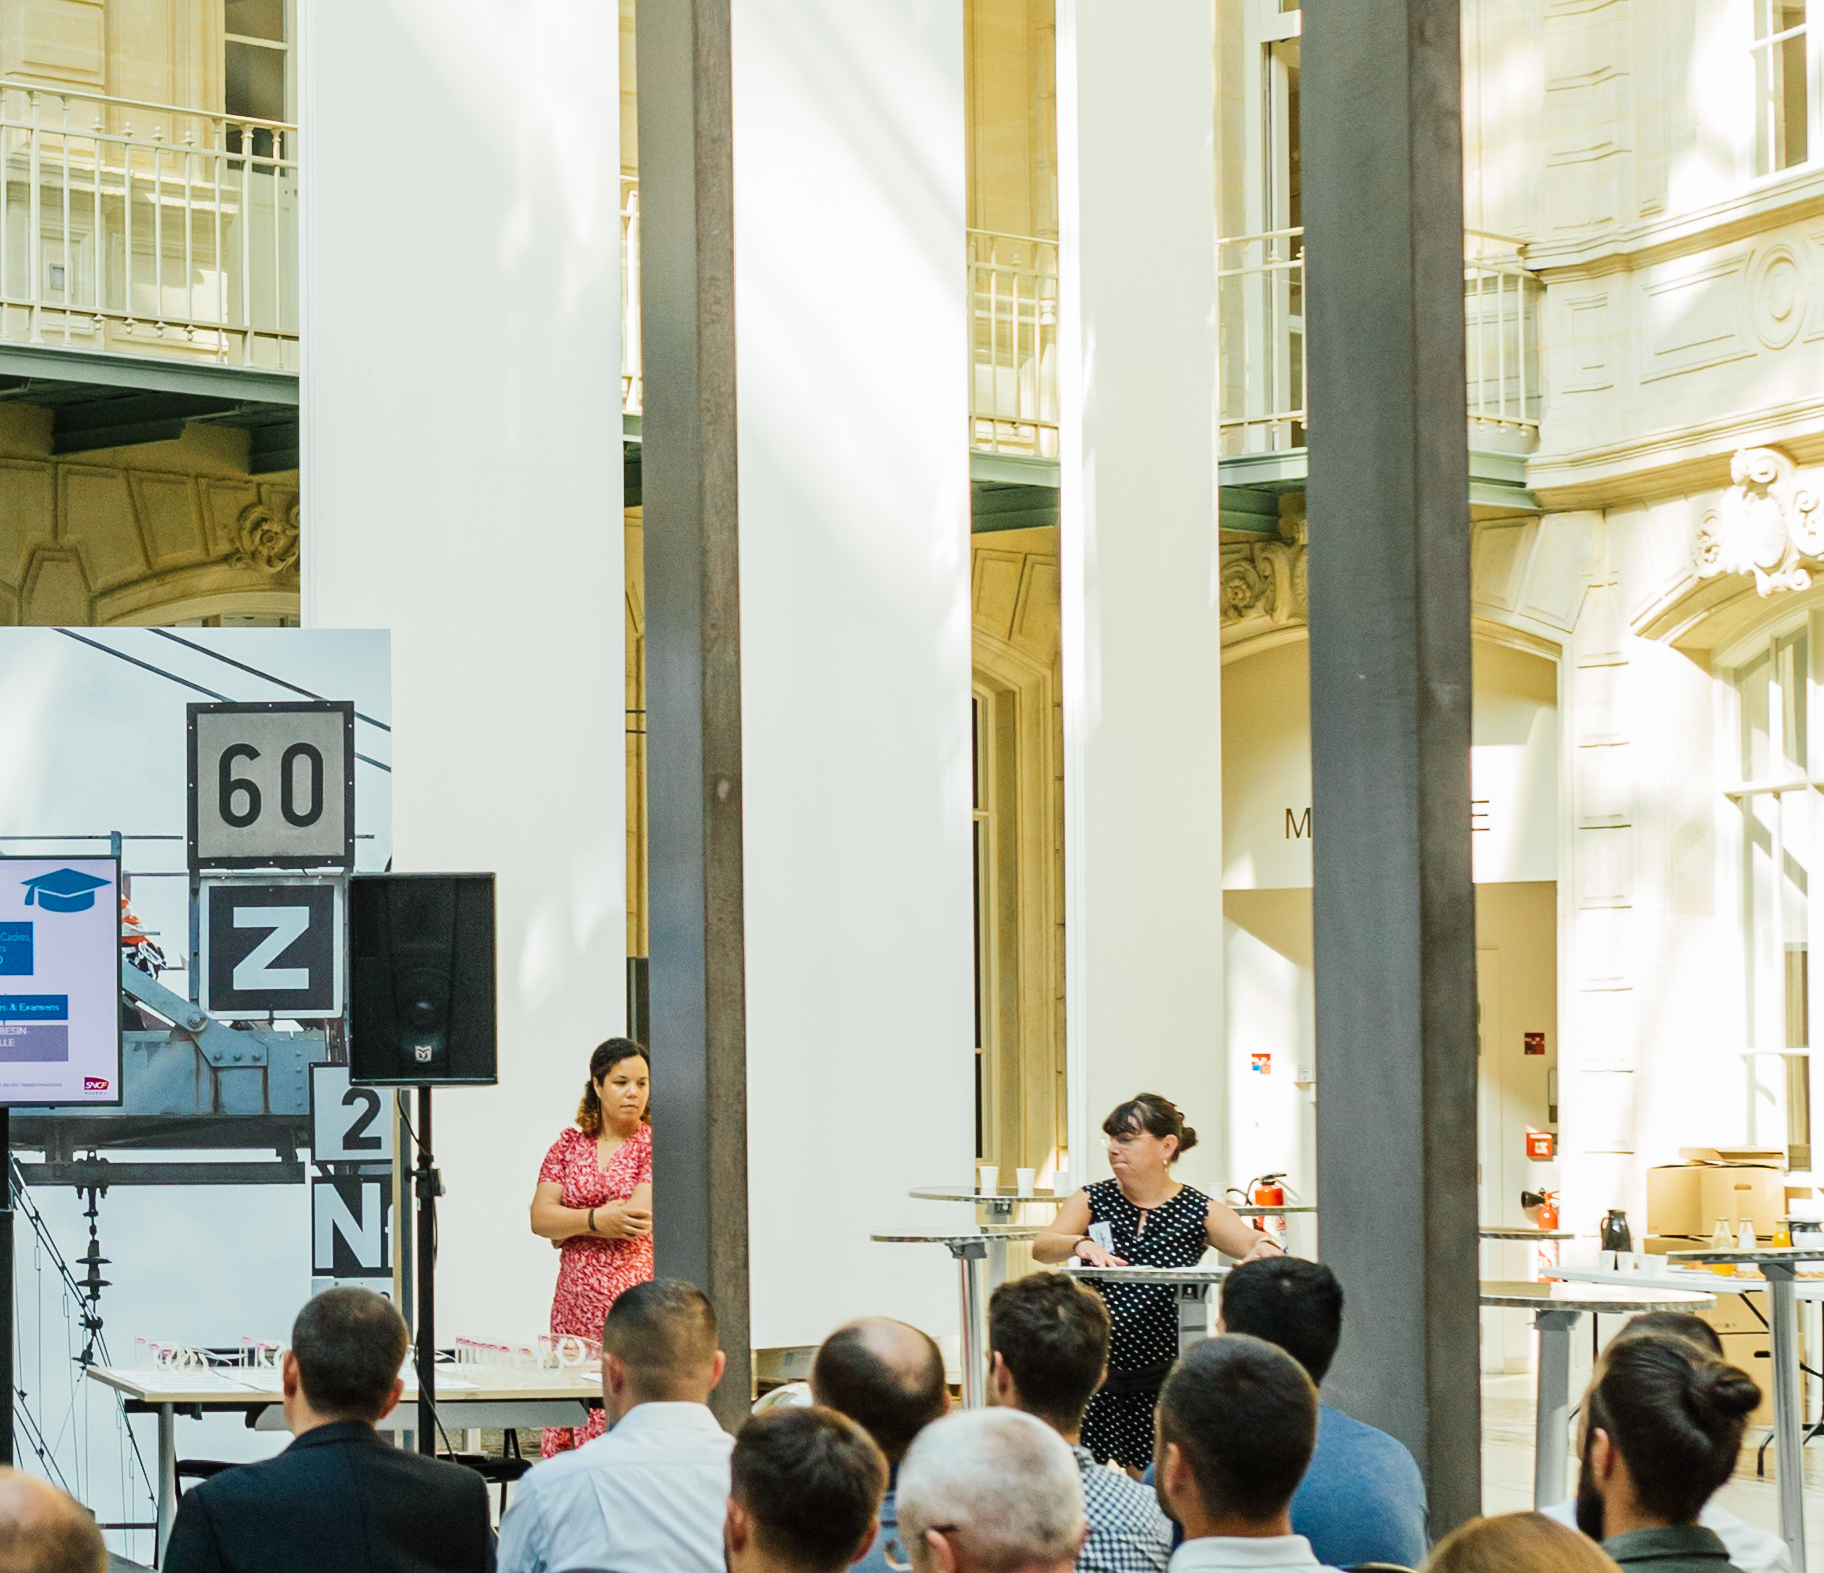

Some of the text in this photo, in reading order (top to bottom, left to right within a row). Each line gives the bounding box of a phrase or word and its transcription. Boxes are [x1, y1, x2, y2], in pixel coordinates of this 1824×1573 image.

[218, 742, 324, 828] 60
[232, 906, 310, 991] Z
[85, 1081, 108, 1089] SNCF
[341, 1087, 382, 1151] 2
